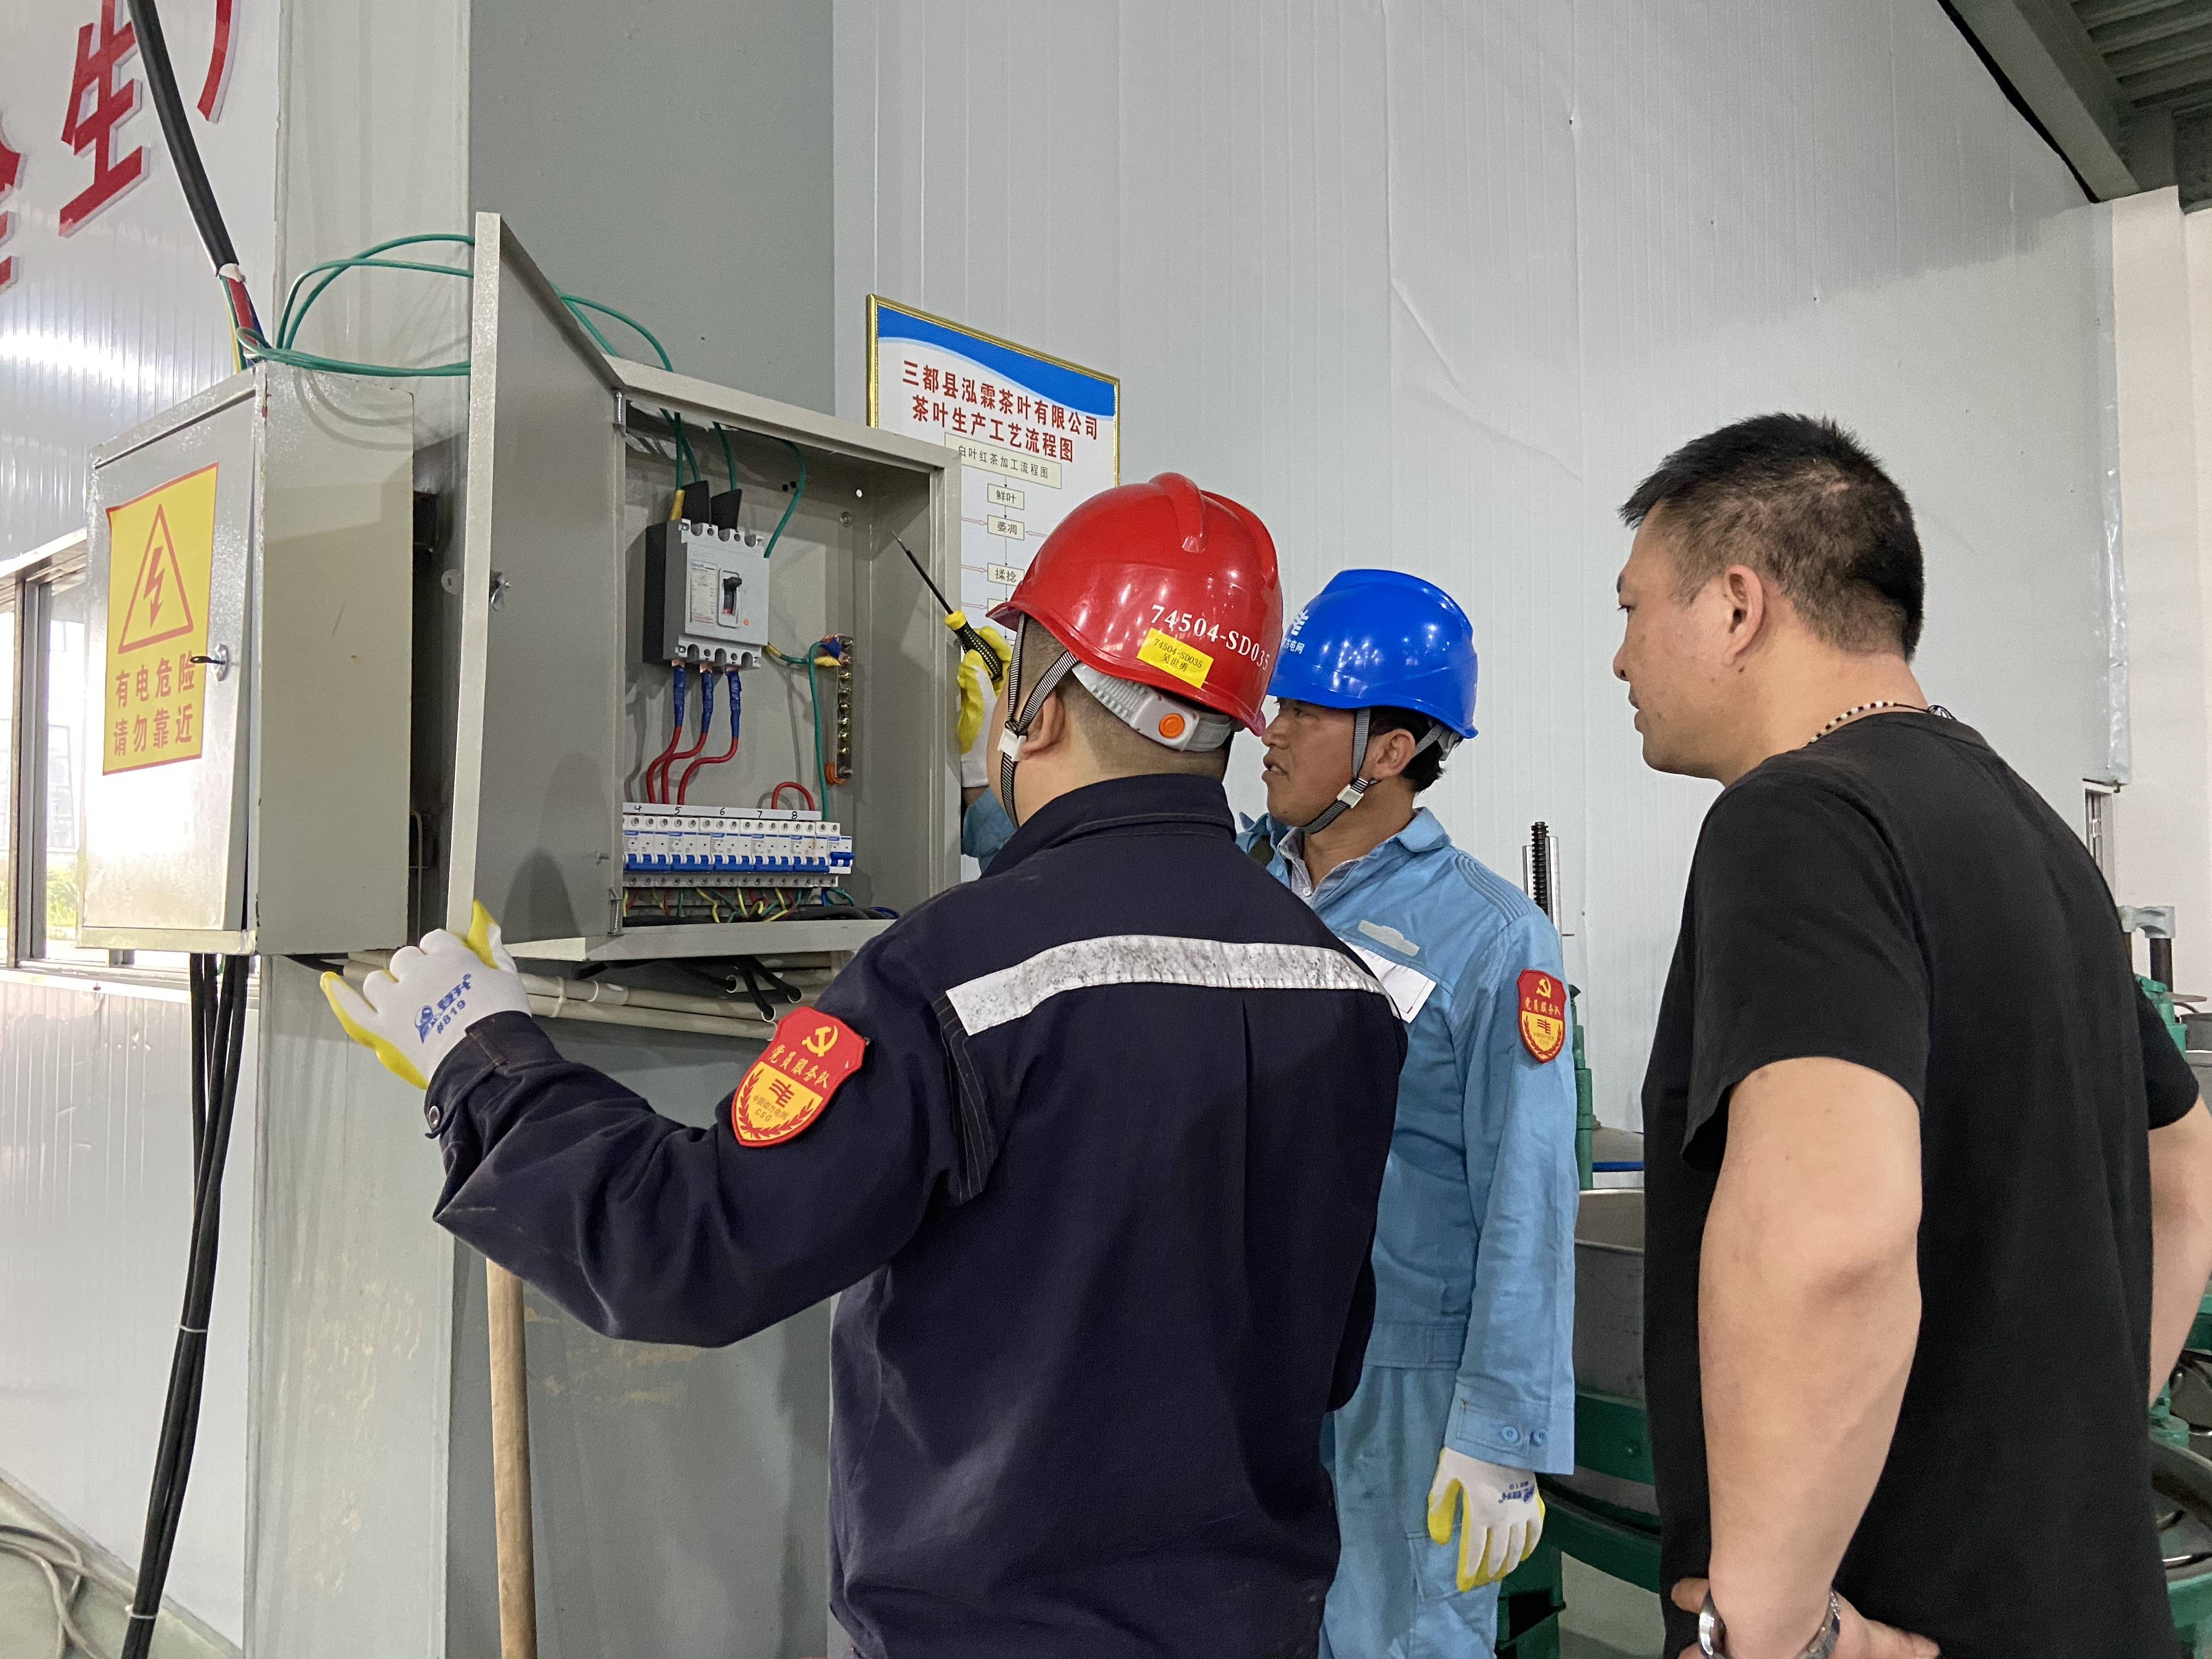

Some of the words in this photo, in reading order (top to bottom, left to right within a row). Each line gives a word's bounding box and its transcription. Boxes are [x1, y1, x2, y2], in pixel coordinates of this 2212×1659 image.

[902, 360, 1097, 440] 三都县泓霖茶叶有限公司
[912, 394, 1073, 462] 茶叶生产工艺流程图
[958, 445, 1048, 479] 白叶红茶加工流程图
[996, 489, 1017, 504] 鲜叶
[997, 521, 1018, 535] 萎凋
[995, 567, 1017, 583] 揉捻
[1150, 605, 1270, 671] 74504-SD035
[1154, 639, 1204, 668] 74504-SD035
[116, 650, 196, 708] 有电危险
[1161, 652, 1188, 672] 吴世勇
[113, 702, 193, 757] 请勿靠近
[674, 806, 682, 815] 5
[719, 807, 725, 816] 6
[757, 810, 763, 819] 7
[791, 811, 798, 819] 8
[436, 999, 466, 1035] #819
[768, 1043, 831, 1088] 党员服务队
[755, 1109, 772, 1121] CSG
